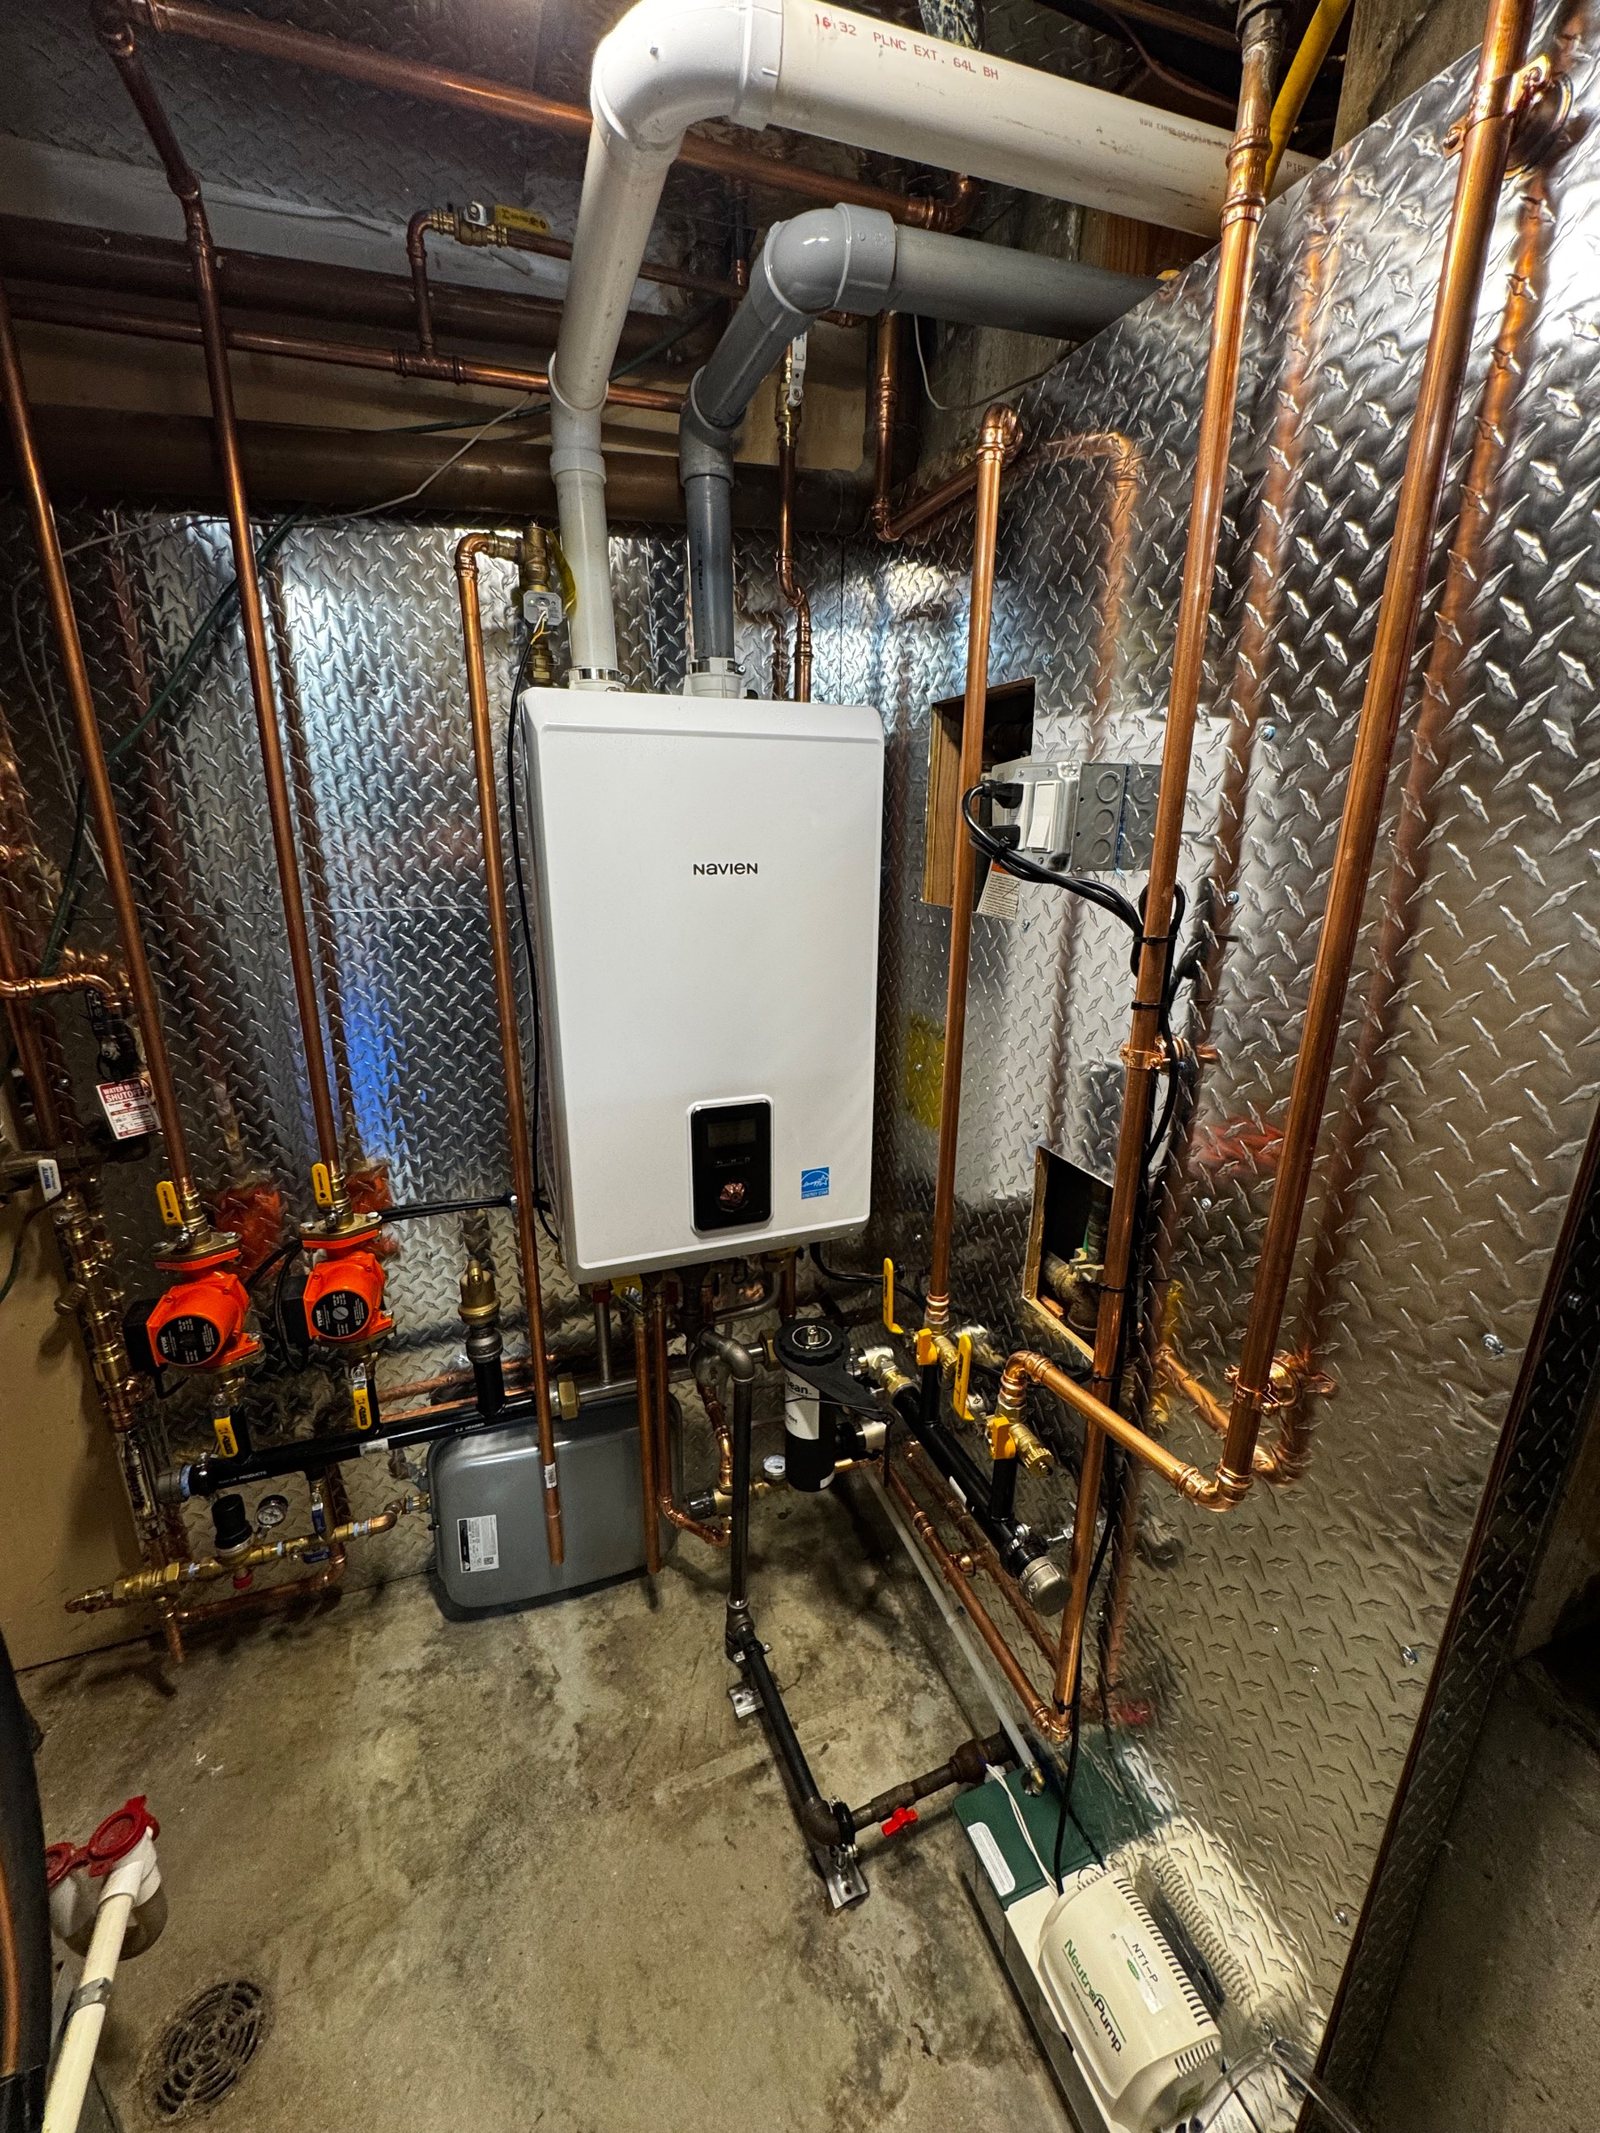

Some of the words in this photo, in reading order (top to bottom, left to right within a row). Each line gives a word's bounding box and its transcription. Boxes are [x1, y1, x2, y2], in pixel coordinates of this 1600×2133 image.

[873, 31, 907, 52] PLNC
[953, 57, 977, 73] 64L
[983, 66, 999, 80] BH
[103, 1085, 124, 1095] WATER
[105, 1089, 143, 1103] SHUTOFF
[1132, 1943, 1159, 1982] NT1-P
